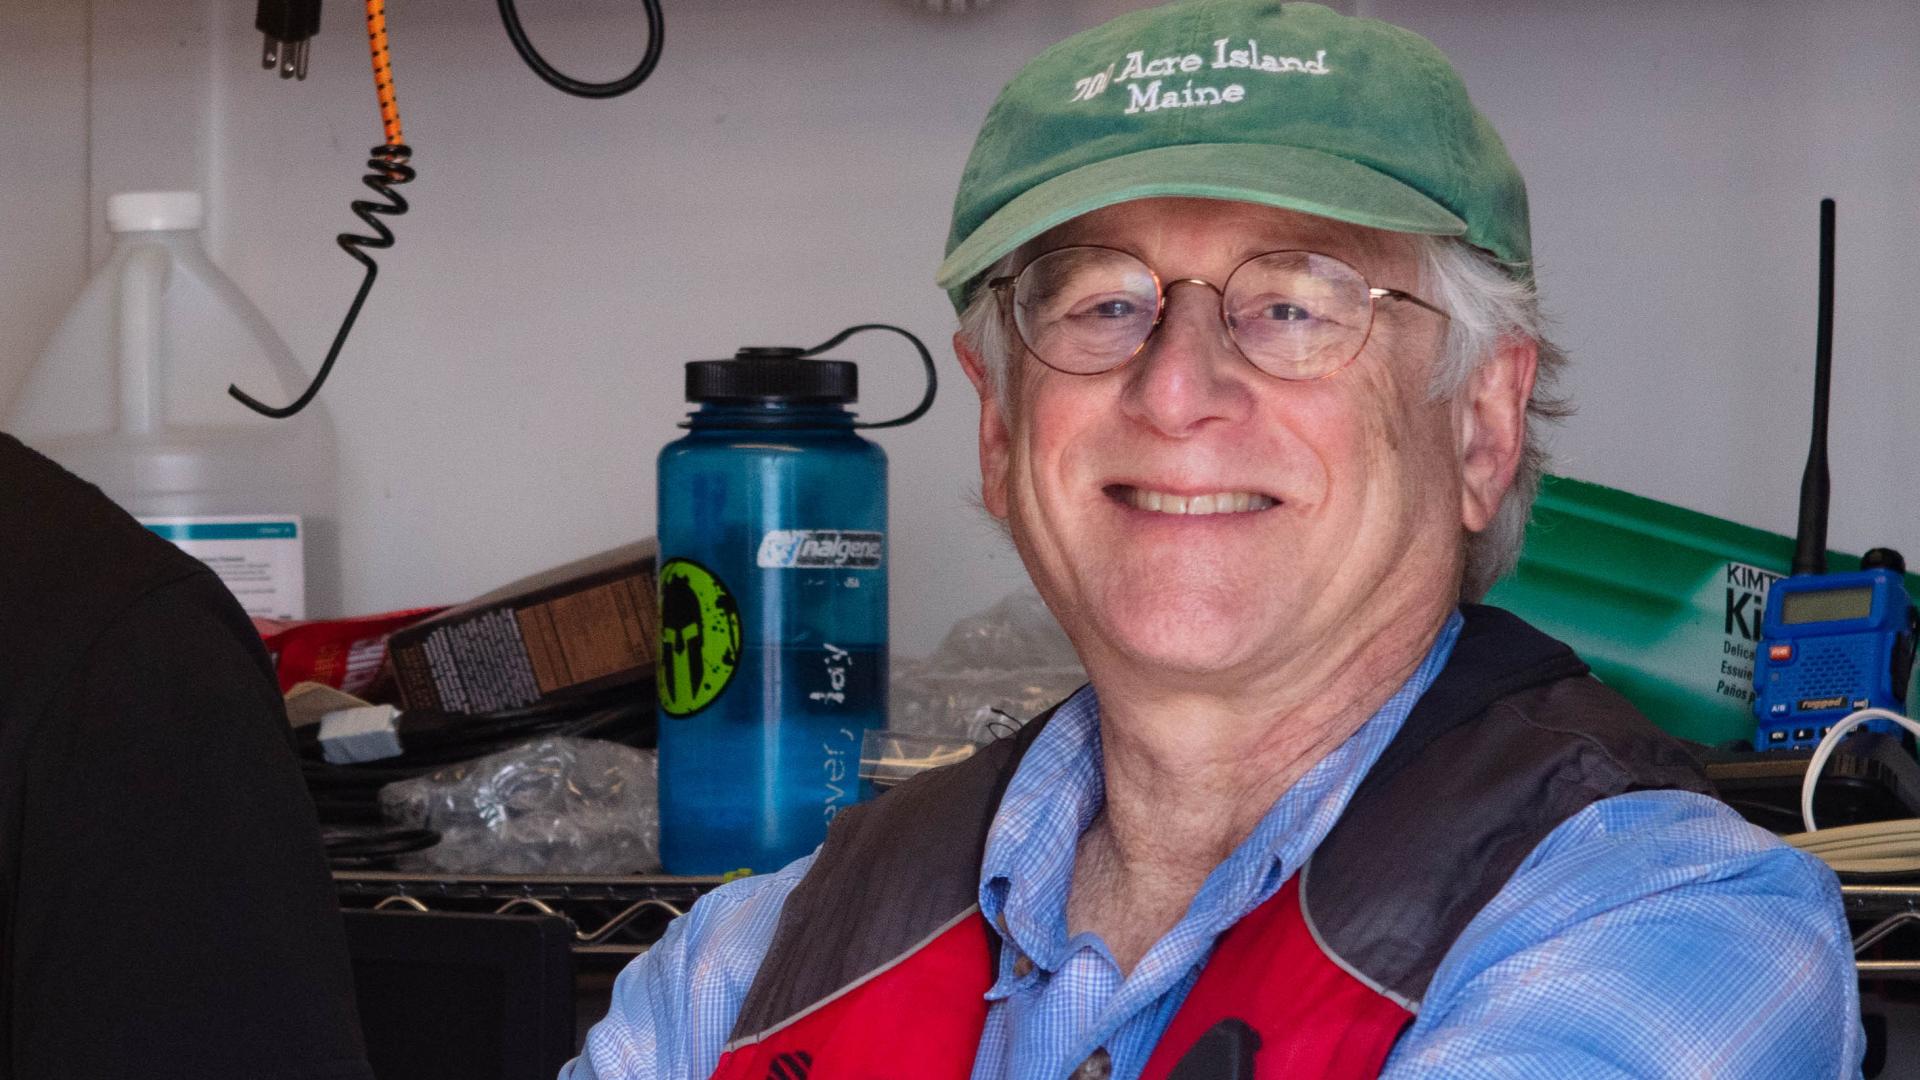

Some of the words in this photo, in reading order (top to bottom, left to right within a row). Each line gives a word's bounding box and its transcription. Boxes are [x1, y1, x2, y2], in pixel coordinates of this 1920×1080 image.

[1114, 50, 1204, 83] Acre
[1211, 37, 1331, 75] Island
[1124, 79, 1246, 115] Maine
[801, 535, 882, 563] nalgene
[1725, 587, 1762, 642] Ki
[1716, 680, 1747, 700] Paños
